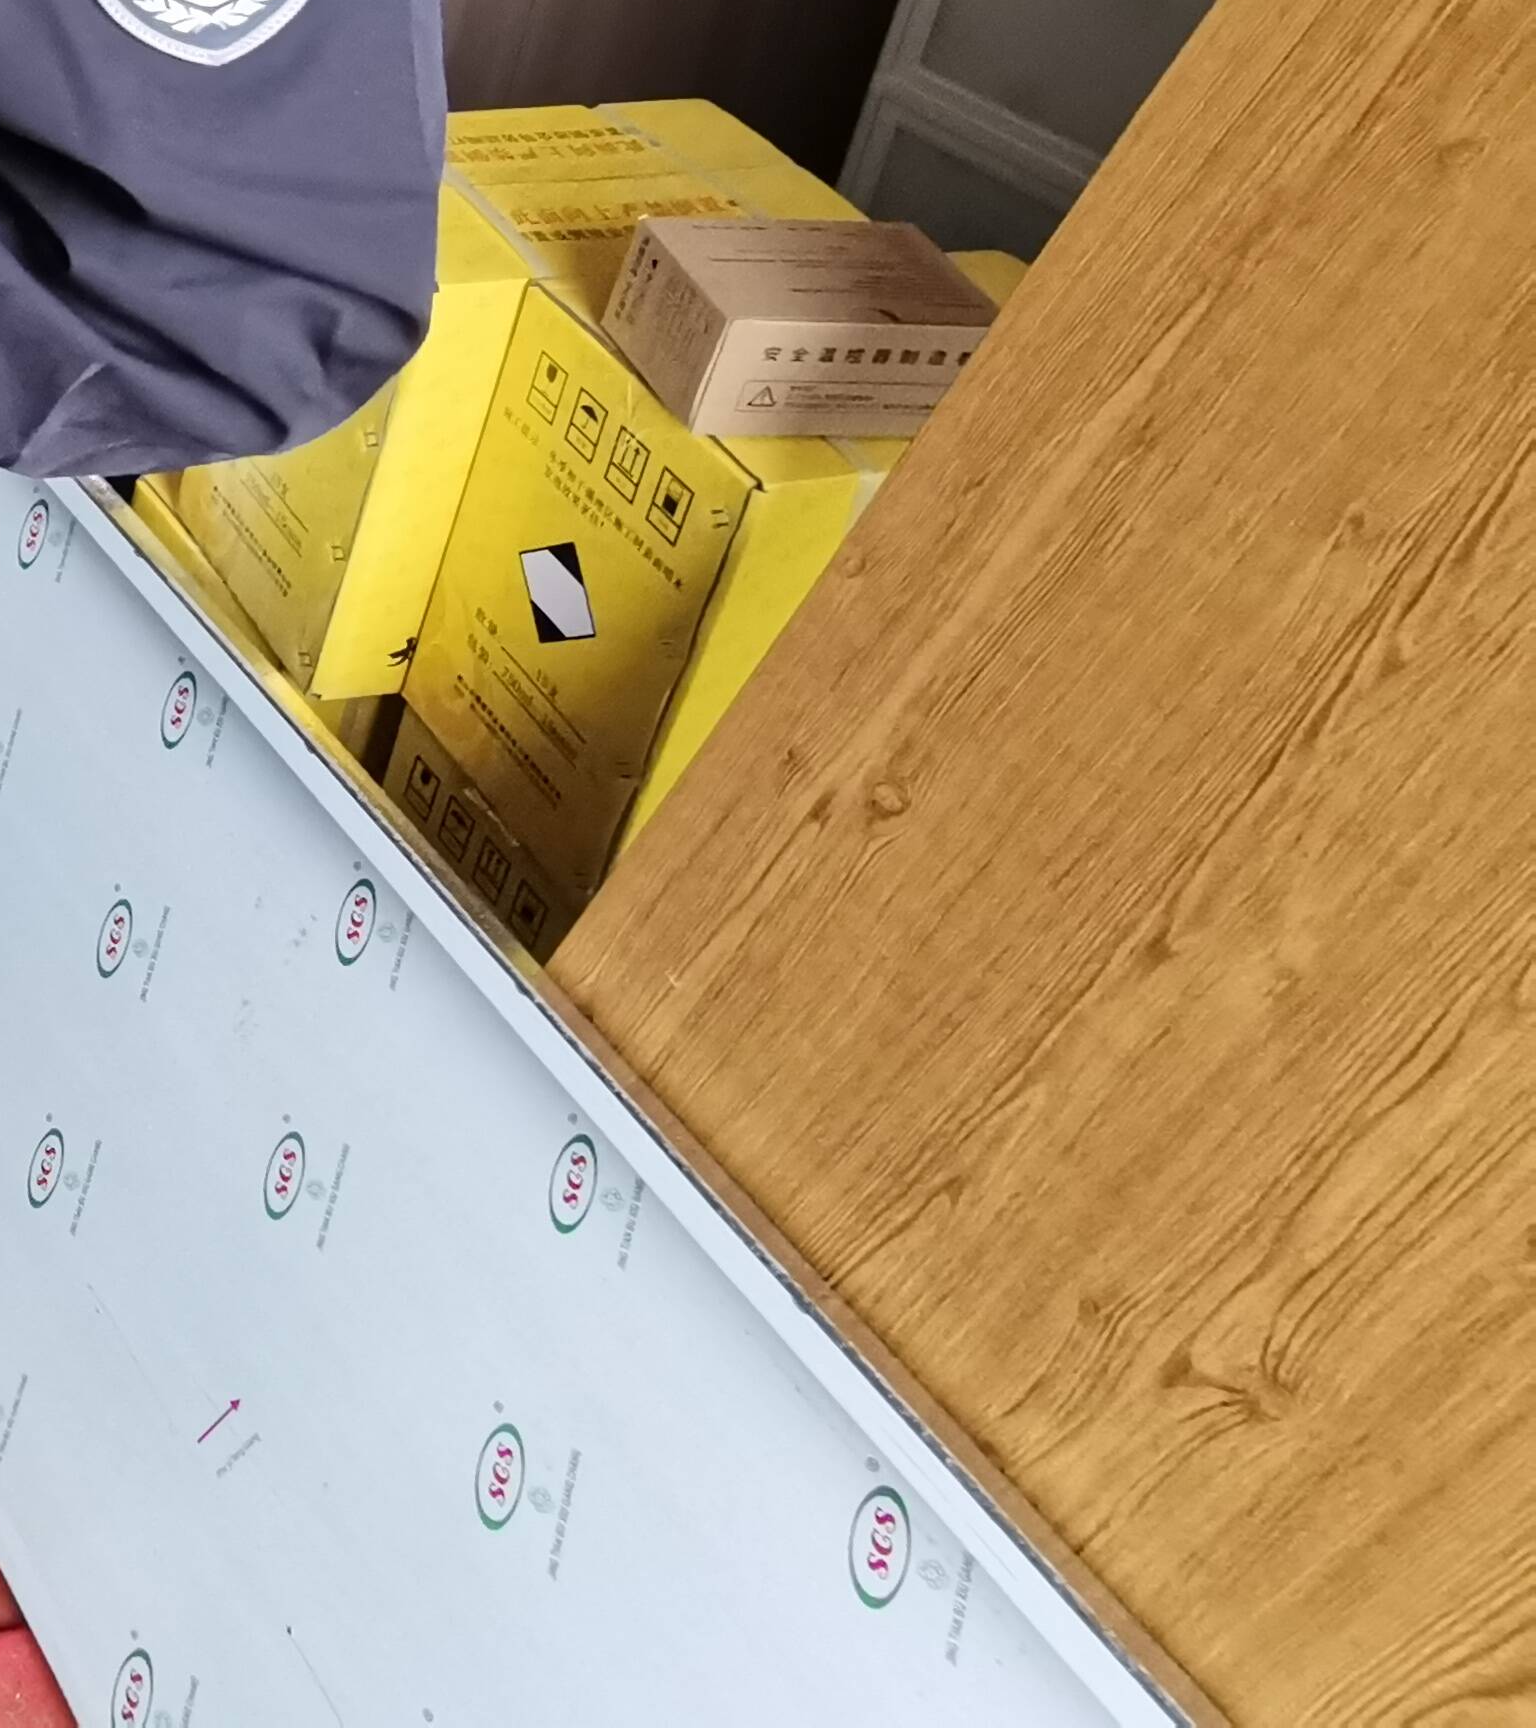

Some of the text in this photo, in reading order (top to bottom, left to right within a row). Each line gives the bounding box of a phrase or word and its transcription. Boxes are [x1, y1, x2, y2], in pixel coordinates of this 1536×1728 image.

[26, 512, 43, 551] SGS
[171, 684, 189, 729] SGS
[106, 913, 126, 959] SGS
[347, 894, 368, 943] SGS
[37, 1143, 57, 1191] SGS
[274, 1148, 298, 1199] SGS
[562, 1152, 587, 1210] SGS
[487, 1443, 513, 1506] SGS
[866, 1506, 896, 1580] SGS
